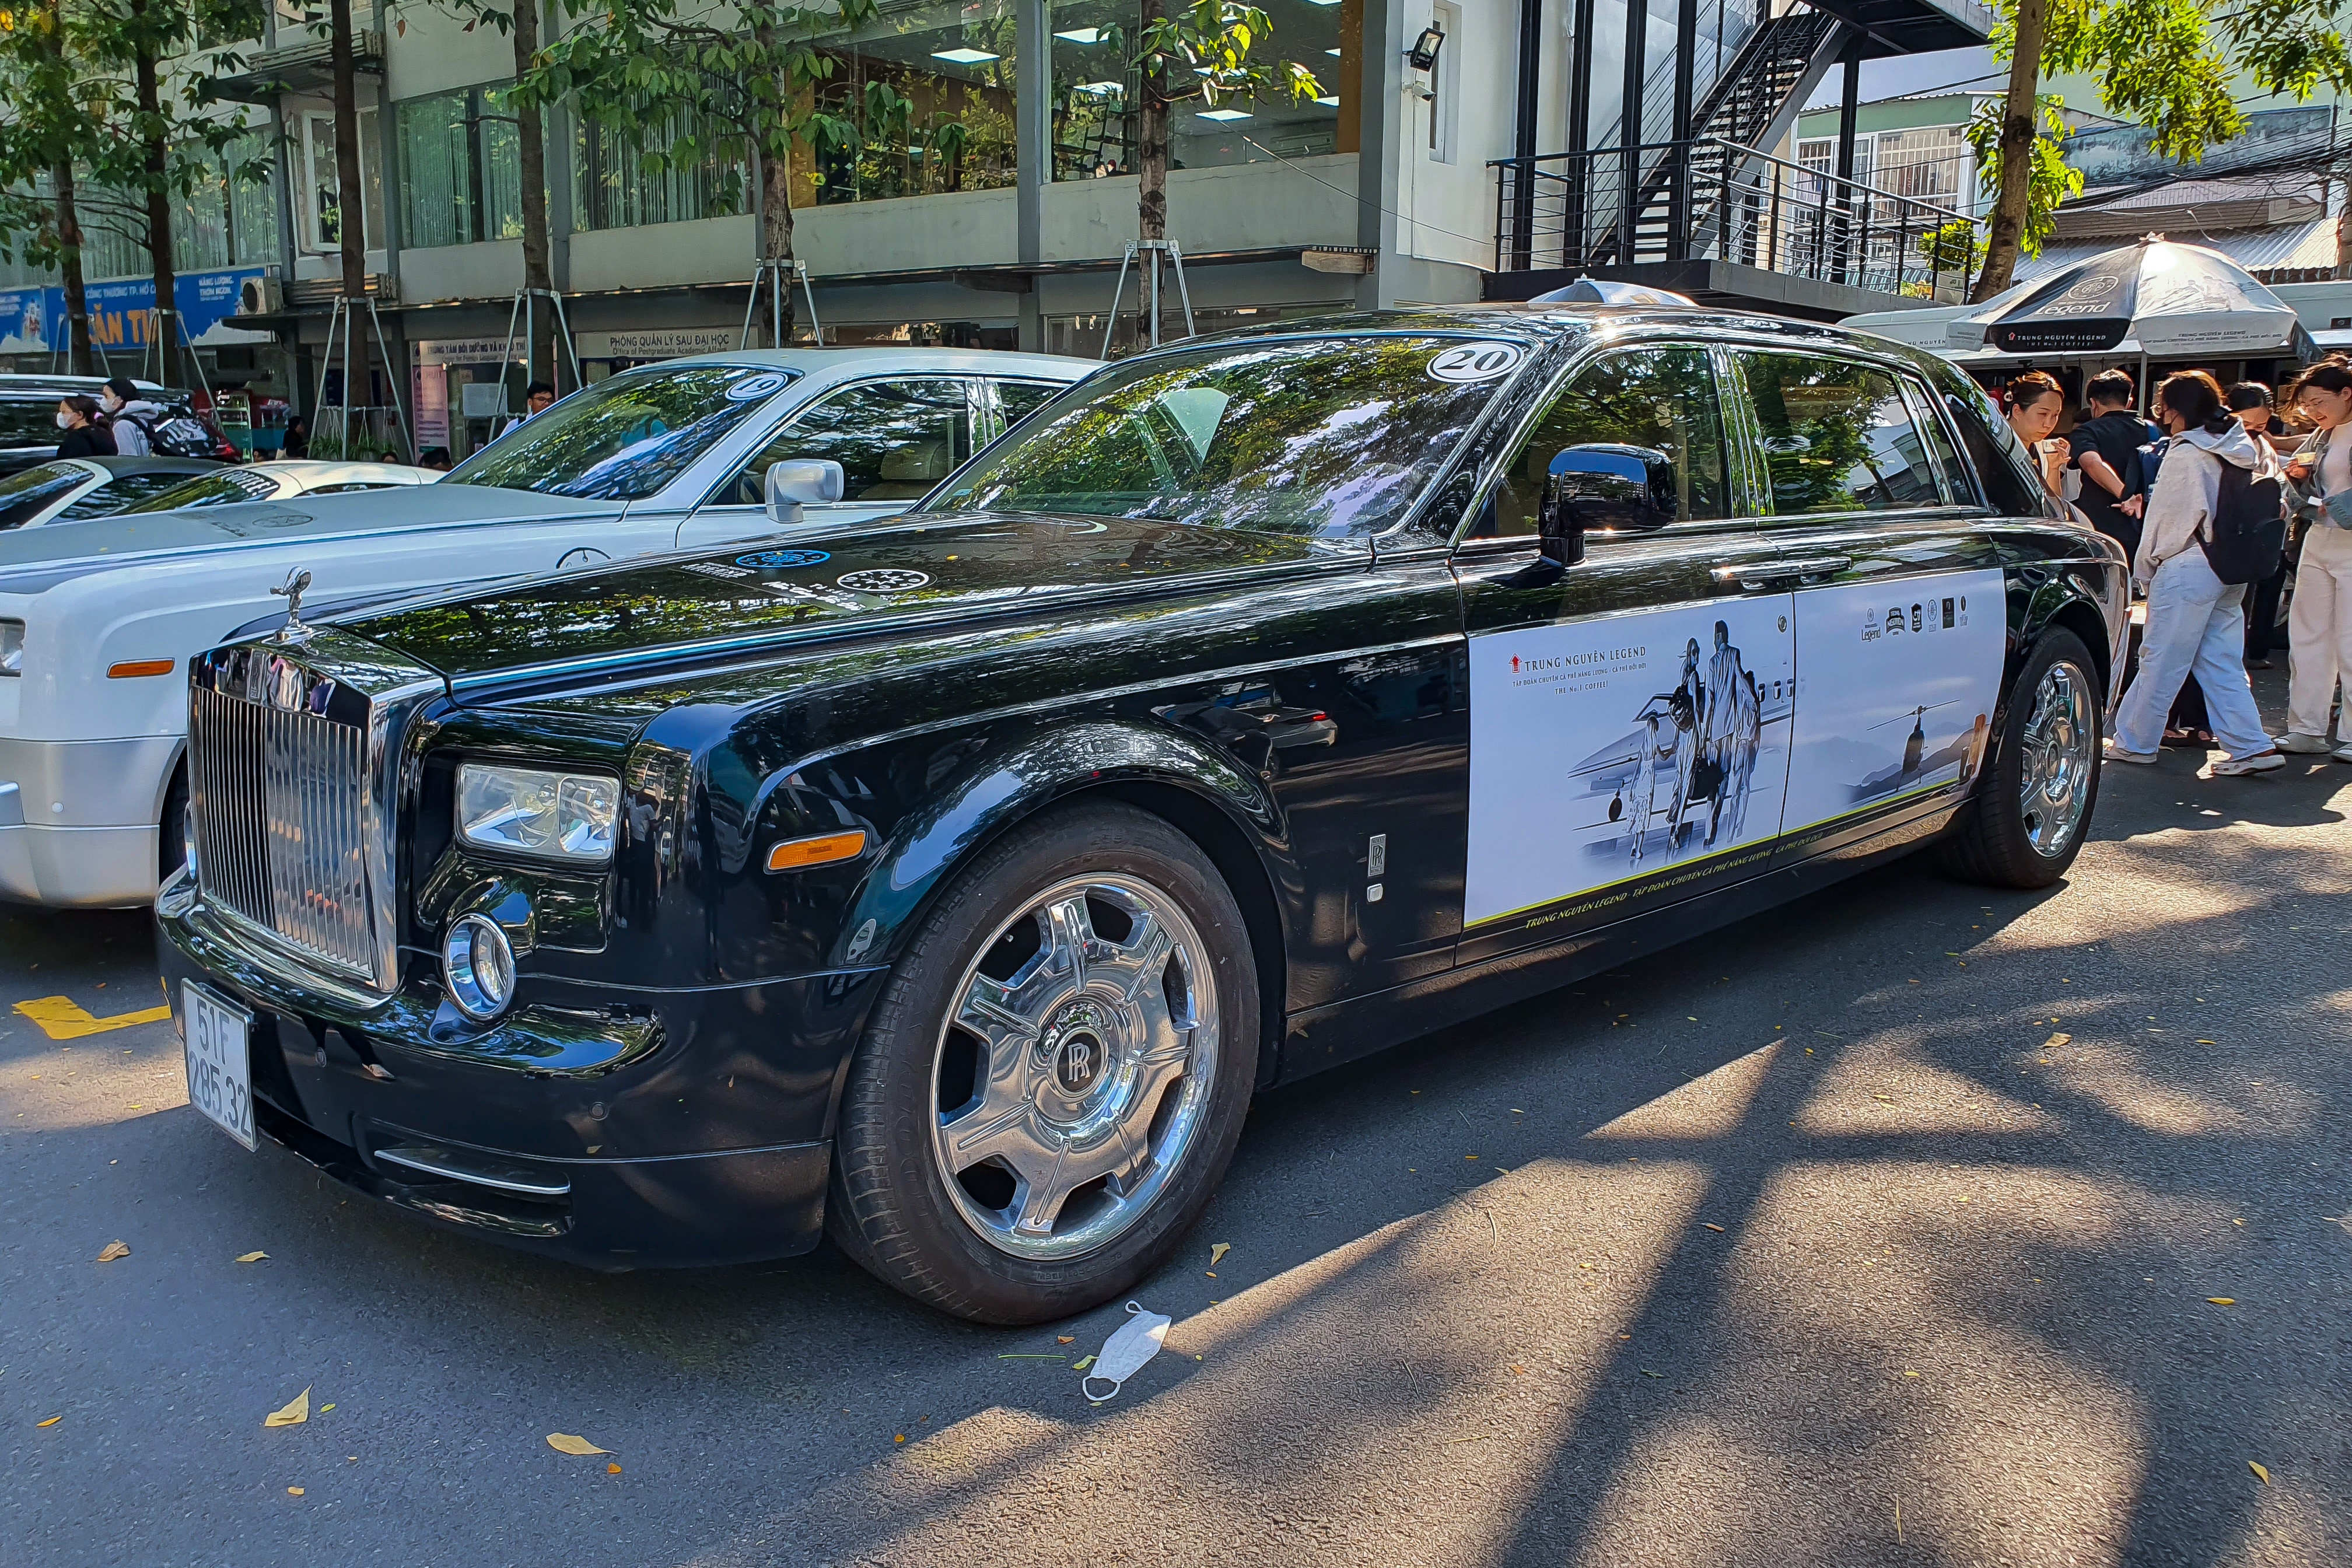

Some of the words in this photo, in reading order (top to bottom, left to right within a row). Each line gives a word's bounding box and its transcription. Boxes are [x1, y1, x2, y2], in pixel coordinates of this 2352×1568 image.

[2034, 302, 2112, 316] Legend
[89, 303, 124, 344] ĂN
[610, 334, 637, 347] PHÒNG
[639, 333, 662, 348] QUẢN
[664, 333, 674, 346] LÝ
[676, 335, 692, 345] SAU
[695, 334, 709, 347] ĐẠI
[711, 334, 729, 348] HỌC
[1436, 350, 1509, 371] 20
[734, 377, 778, 393] 19
[1861, 626, 1881, 642] Legend
[1524, 657, 1560, 671] TRUNG
[1565, 650, 1605, 667] NGUYÊN
[1610, 646, 1646, 660] LEGEND
[1555, 687, 1566, 695] THE
[1569, 684, 1582, 693] No.1
[1525, 912, 1558, 929] TRUNG
[1558, 902, 1595, 919] NGUYÊN
[1594, 892, 1628, 909] LEGEND
[197, 998, 230, 1065] 51F
[1067, 1042, 1091, 1083] RR
[189, 1050, 251, 1138] 285.32
